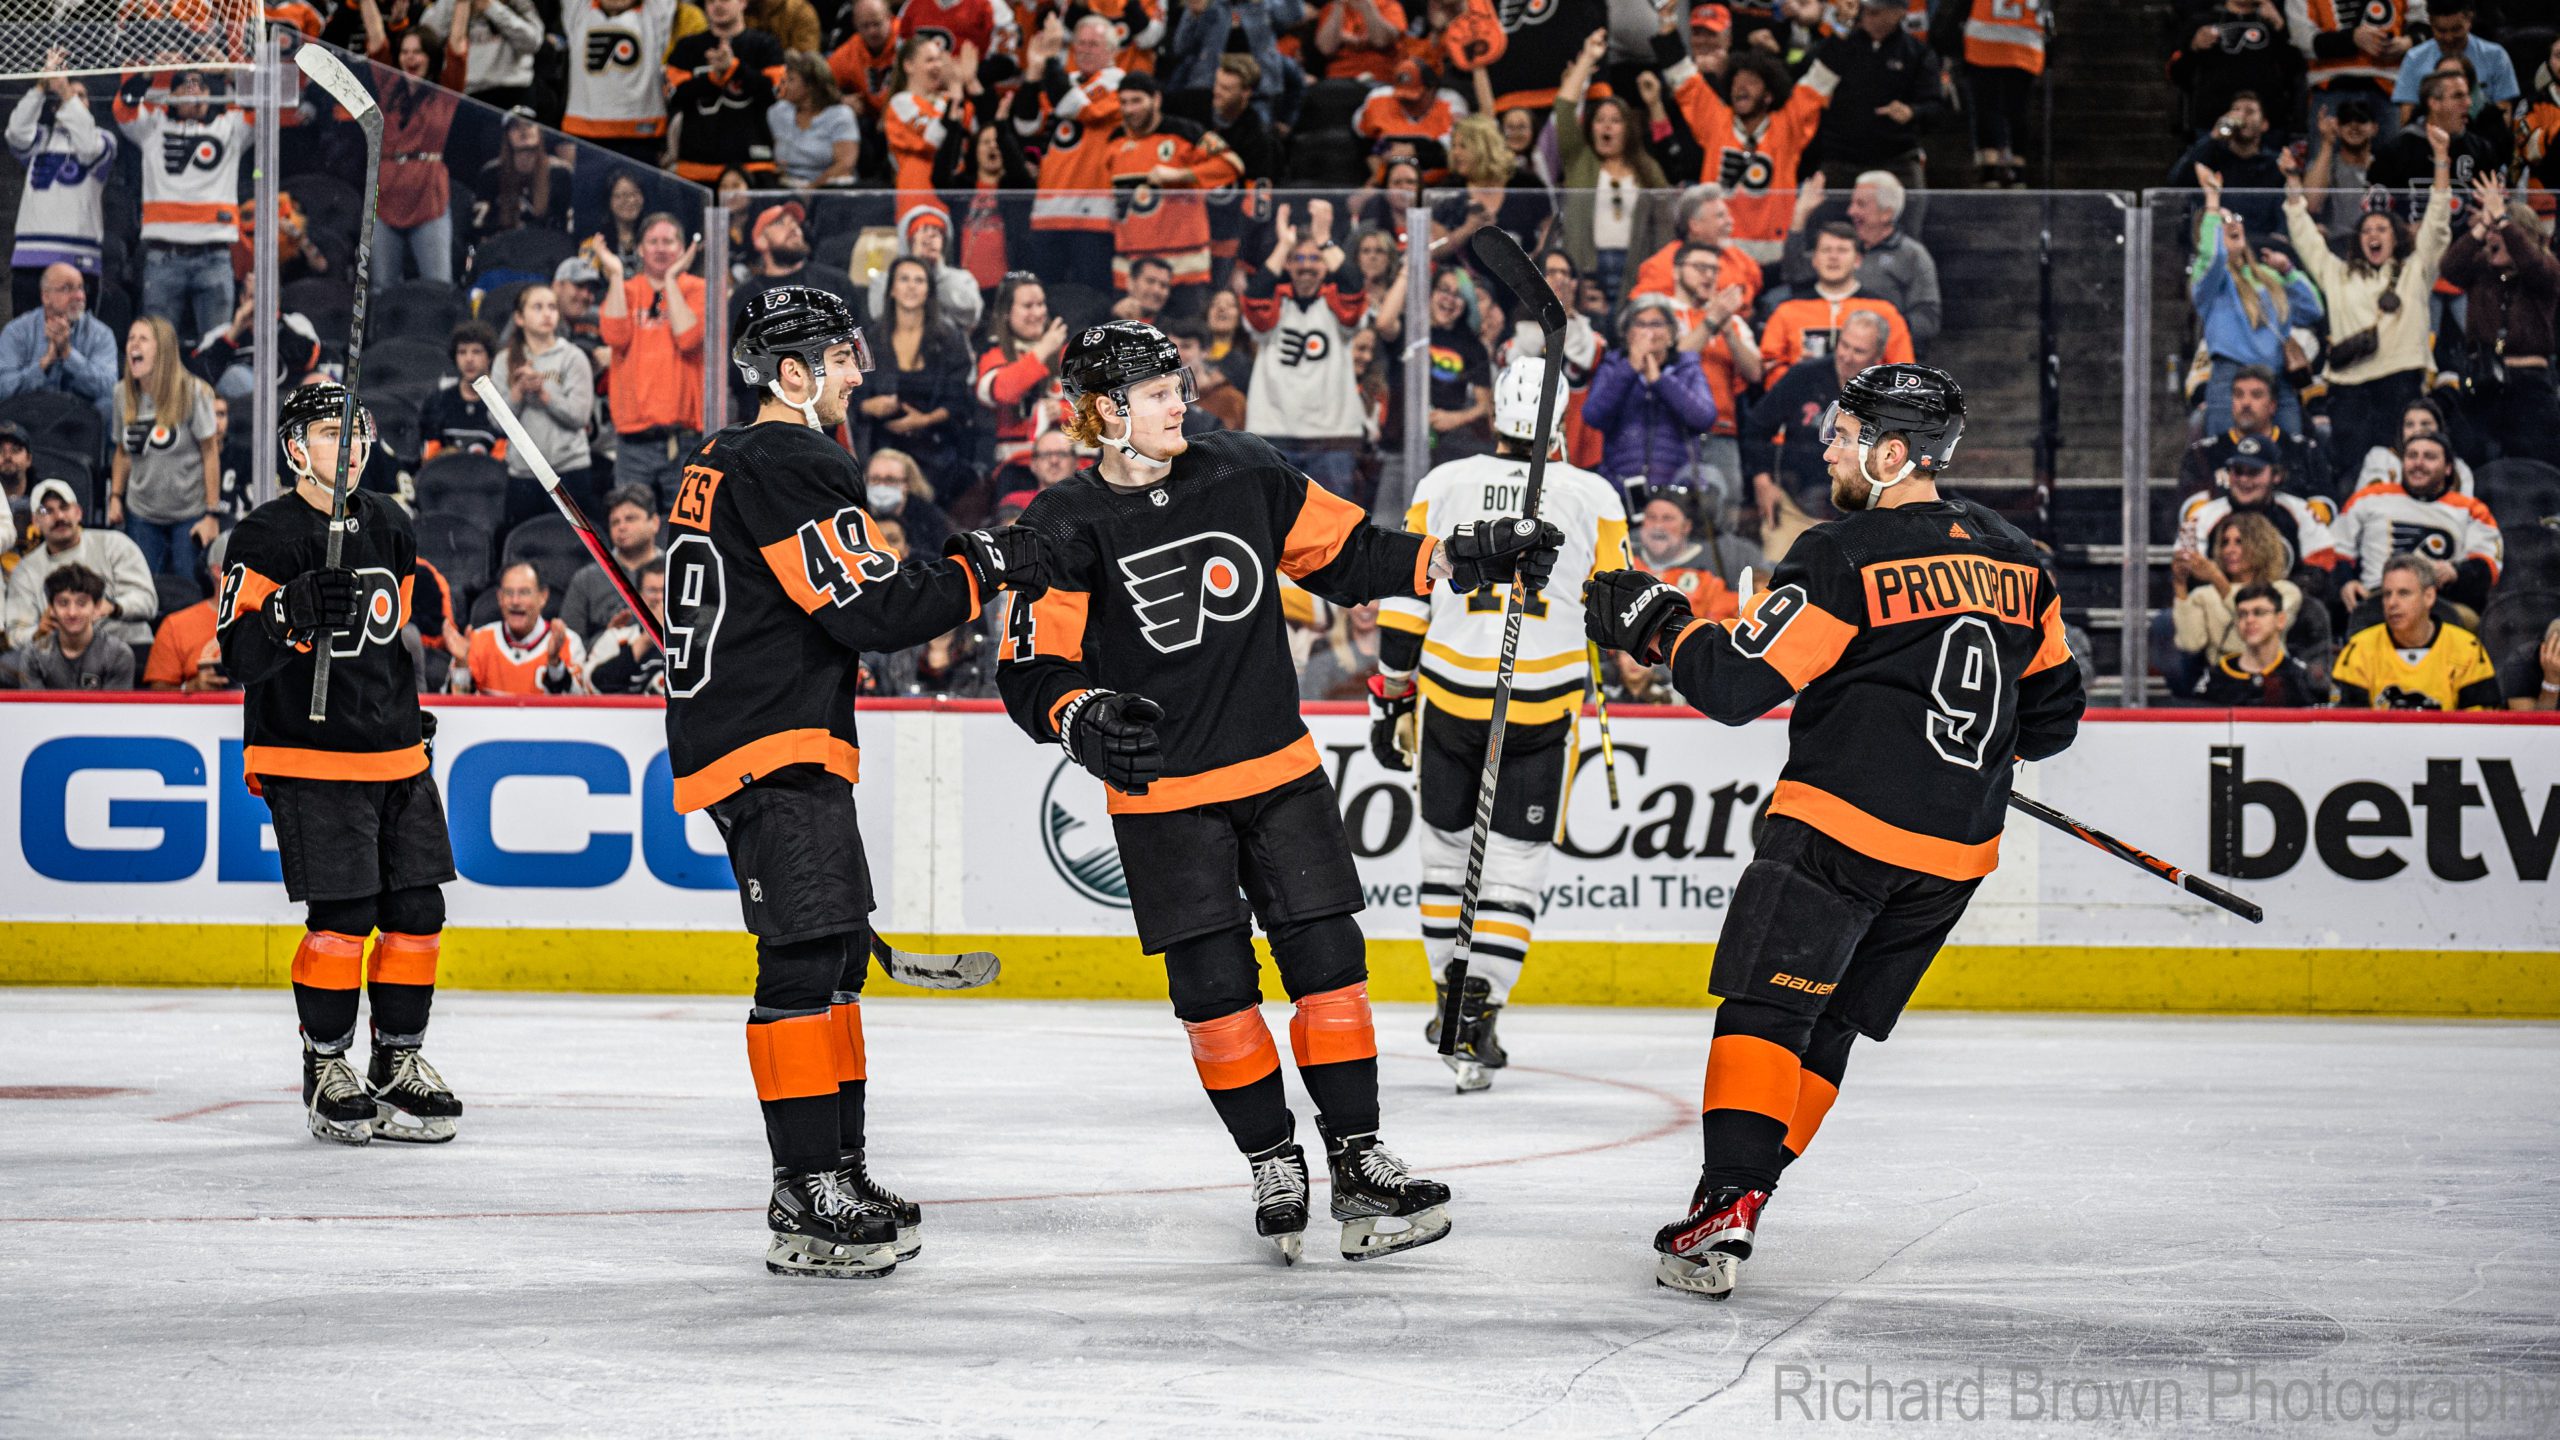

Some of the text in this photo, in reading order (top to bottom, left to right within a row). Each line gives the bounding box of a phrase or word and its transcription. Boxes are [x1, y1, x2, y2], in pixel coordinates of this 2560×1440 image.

[677, 469, 712, 523] ES
[1484, 485, 1547, 516] BOY
[796, 505, 900, 609] 49
[1874, 560, 2034, 621] PROVOROV
[218, 562, 247, 630] 8
[664, 533, 727, 699] 9
[1731, 583, 1808, 659] 9
[1060, 687, 1117, 763] WARRIO
[1926, 615, 2002, 771] 9
[1538, 874, 1640, 917] ysical
[1650, 875, 1735, 908] The
[1674, 1213, 1736, 1251] CCM
